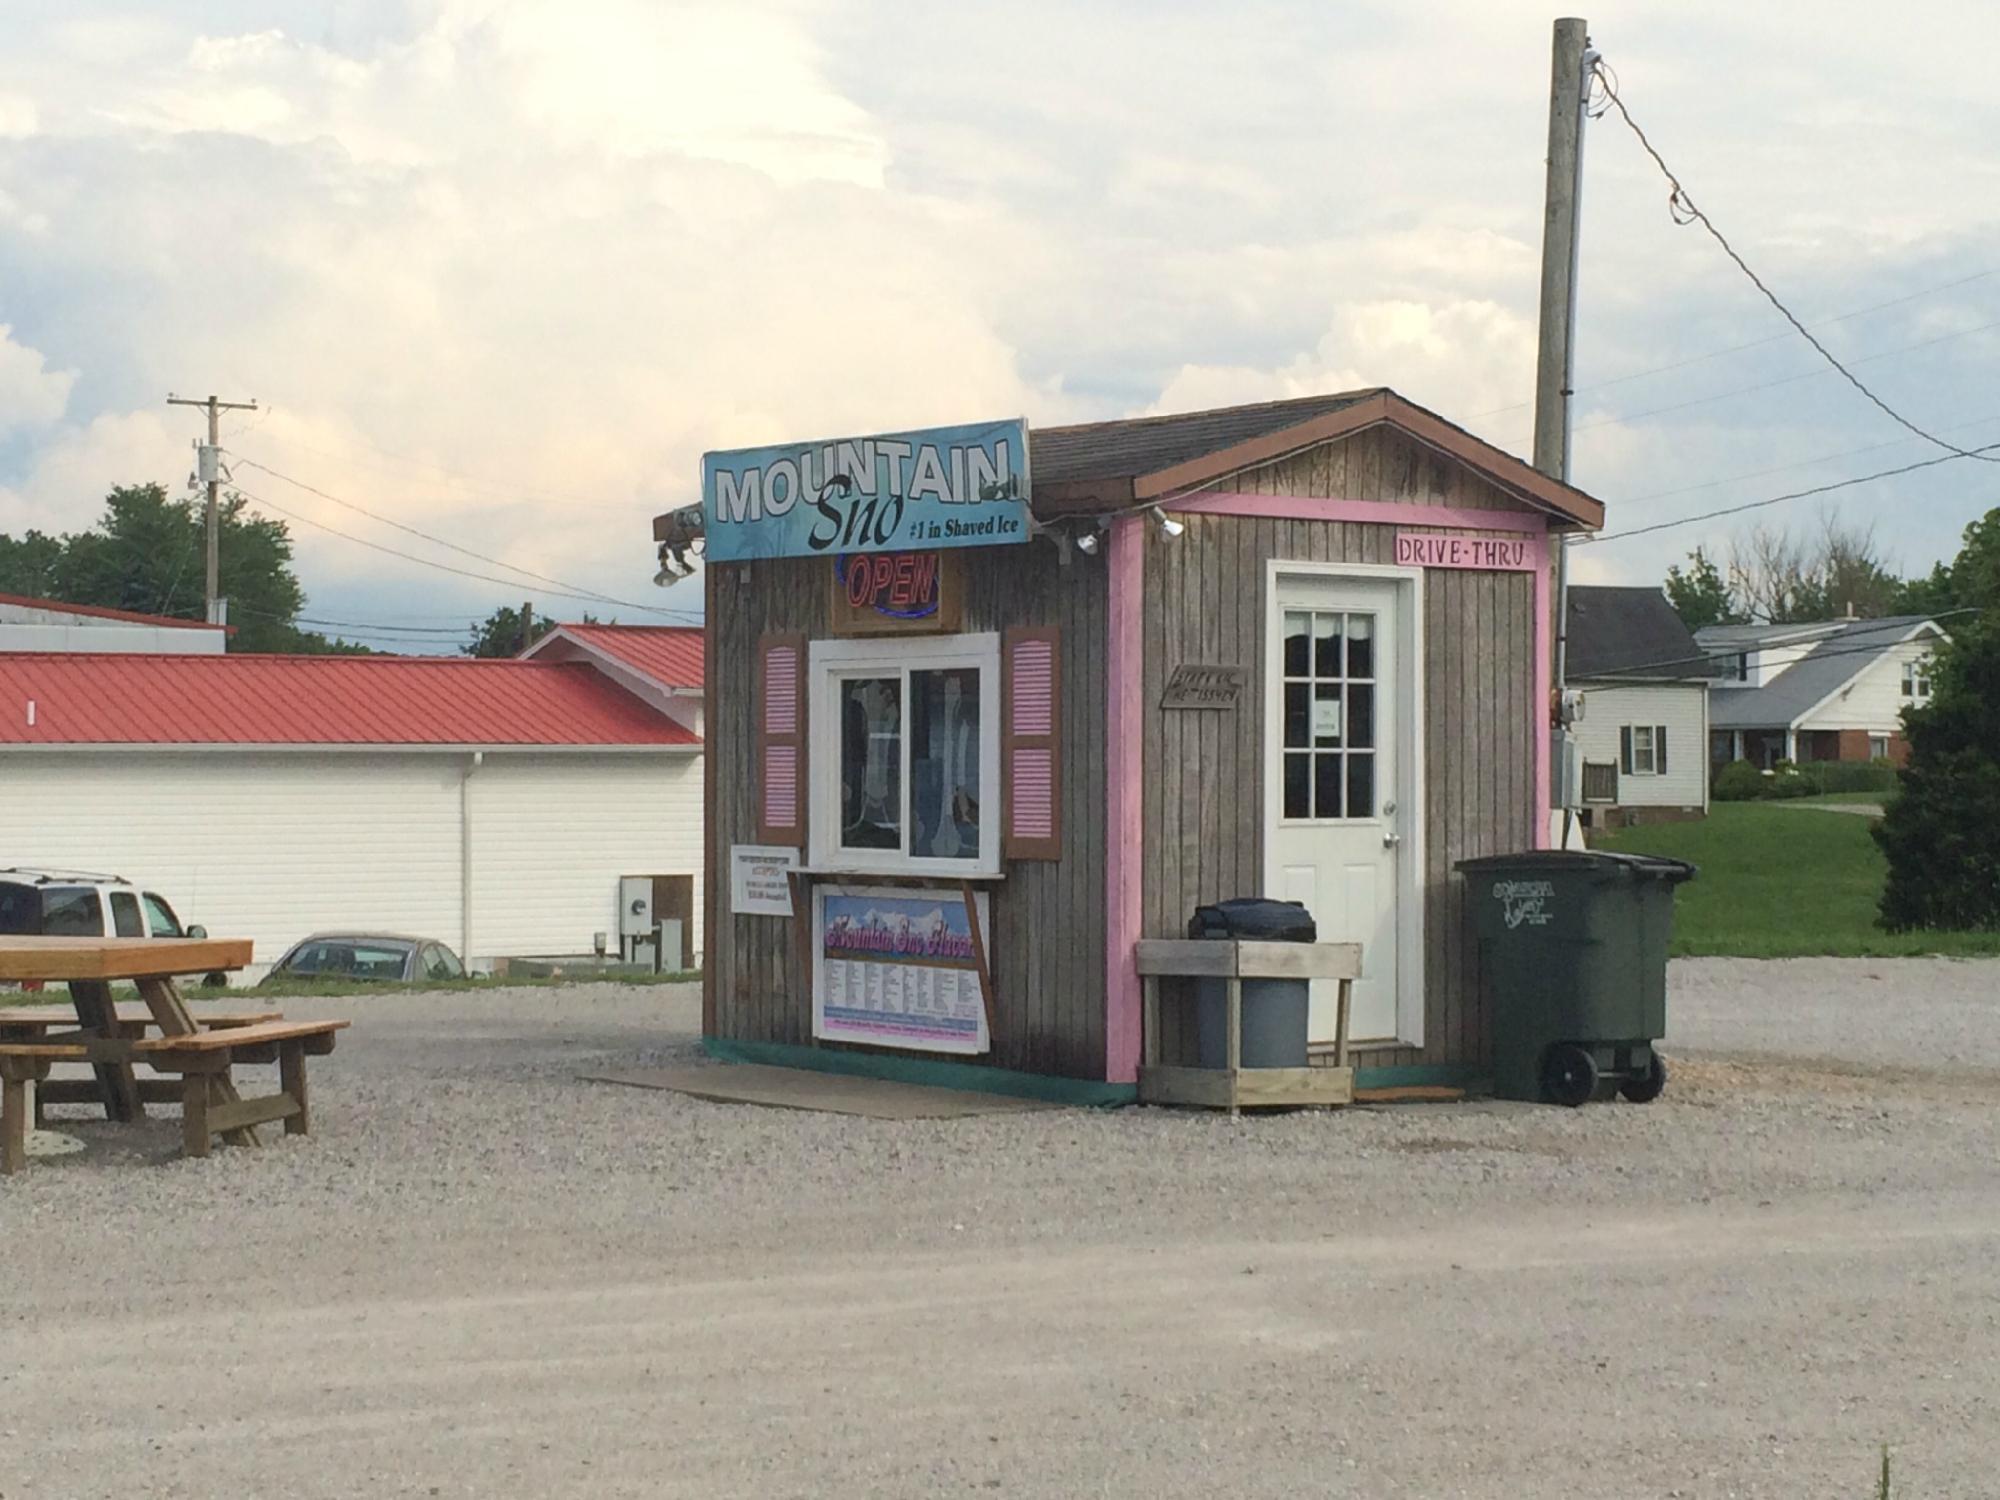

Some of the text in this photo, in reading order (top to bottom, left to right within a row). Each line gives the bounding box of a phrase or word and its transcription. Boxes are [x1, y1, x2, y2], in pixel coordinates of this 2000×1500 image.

[714, 439, 1011, 523] MOUNTAIN
[808, 473, 904, 551] Sno
[910, 514, 1019, 539] #1 in Shaved Ice
[848, 554, 937, 608] OPEN
